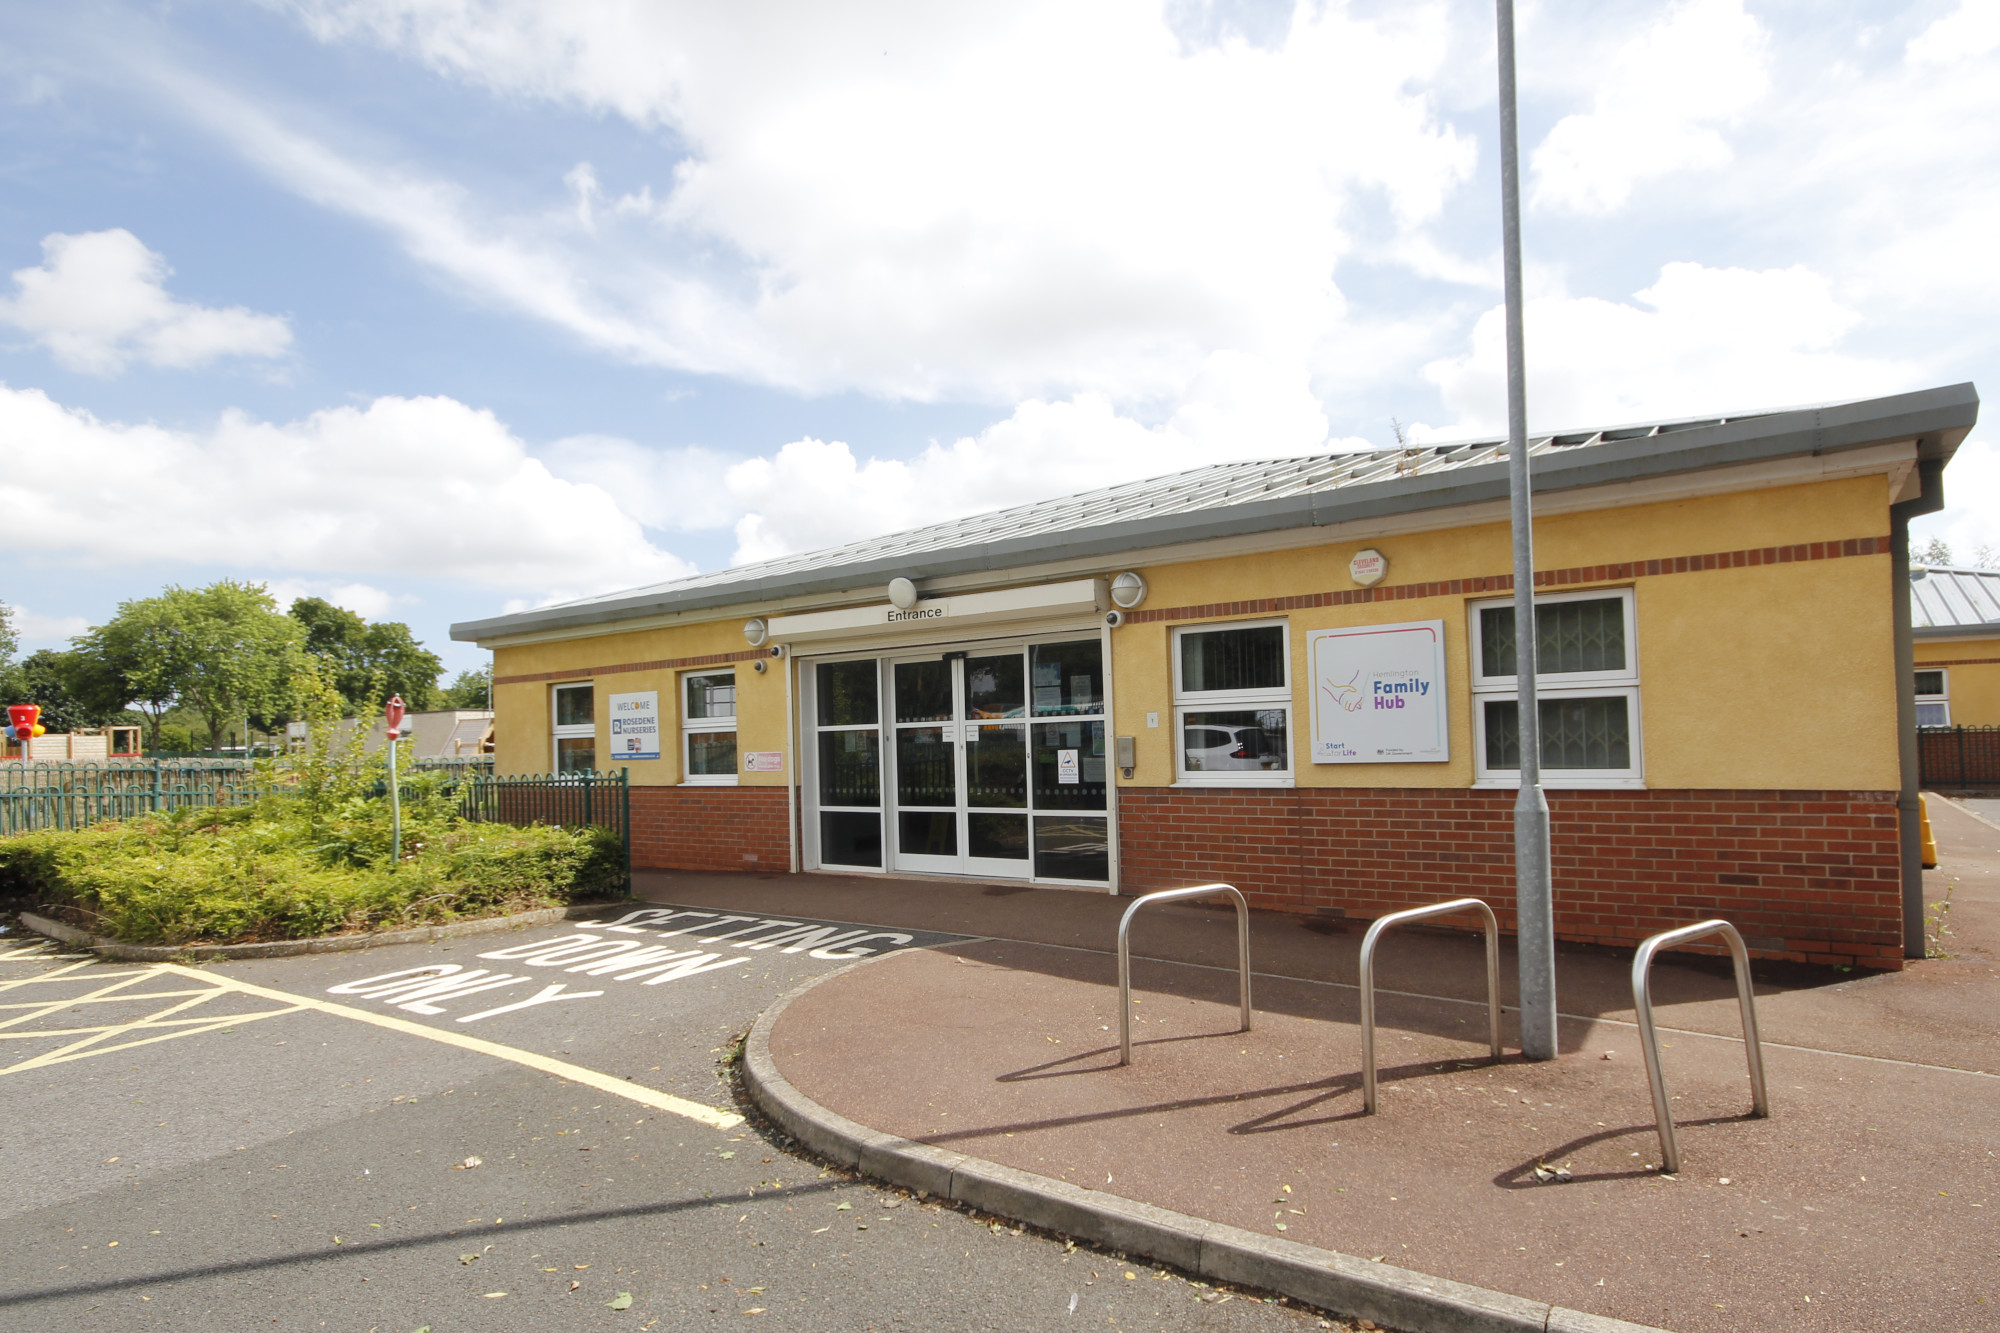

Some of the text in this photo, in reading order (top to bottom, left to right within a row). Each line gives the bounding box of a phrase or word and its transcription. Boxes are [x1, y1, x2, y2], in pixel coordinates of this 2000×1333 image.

[888, 608, 942, 621] Entrance
[1373, 669, 1419, 678] Hemlington
[1373, 678, 1430, 696] Family
[617, 701, 650, 711] WELCOME
[1374, 695, 1405, 710] Hub
[623, 717, 655, 725] ROSEDENE
[623, 726, 656, 734] NURSERIES
[574, 908, 914, 960] SETTING
[477, 932, 751, 986] DOWN
[326, 963, 605, 1024] ONLY
